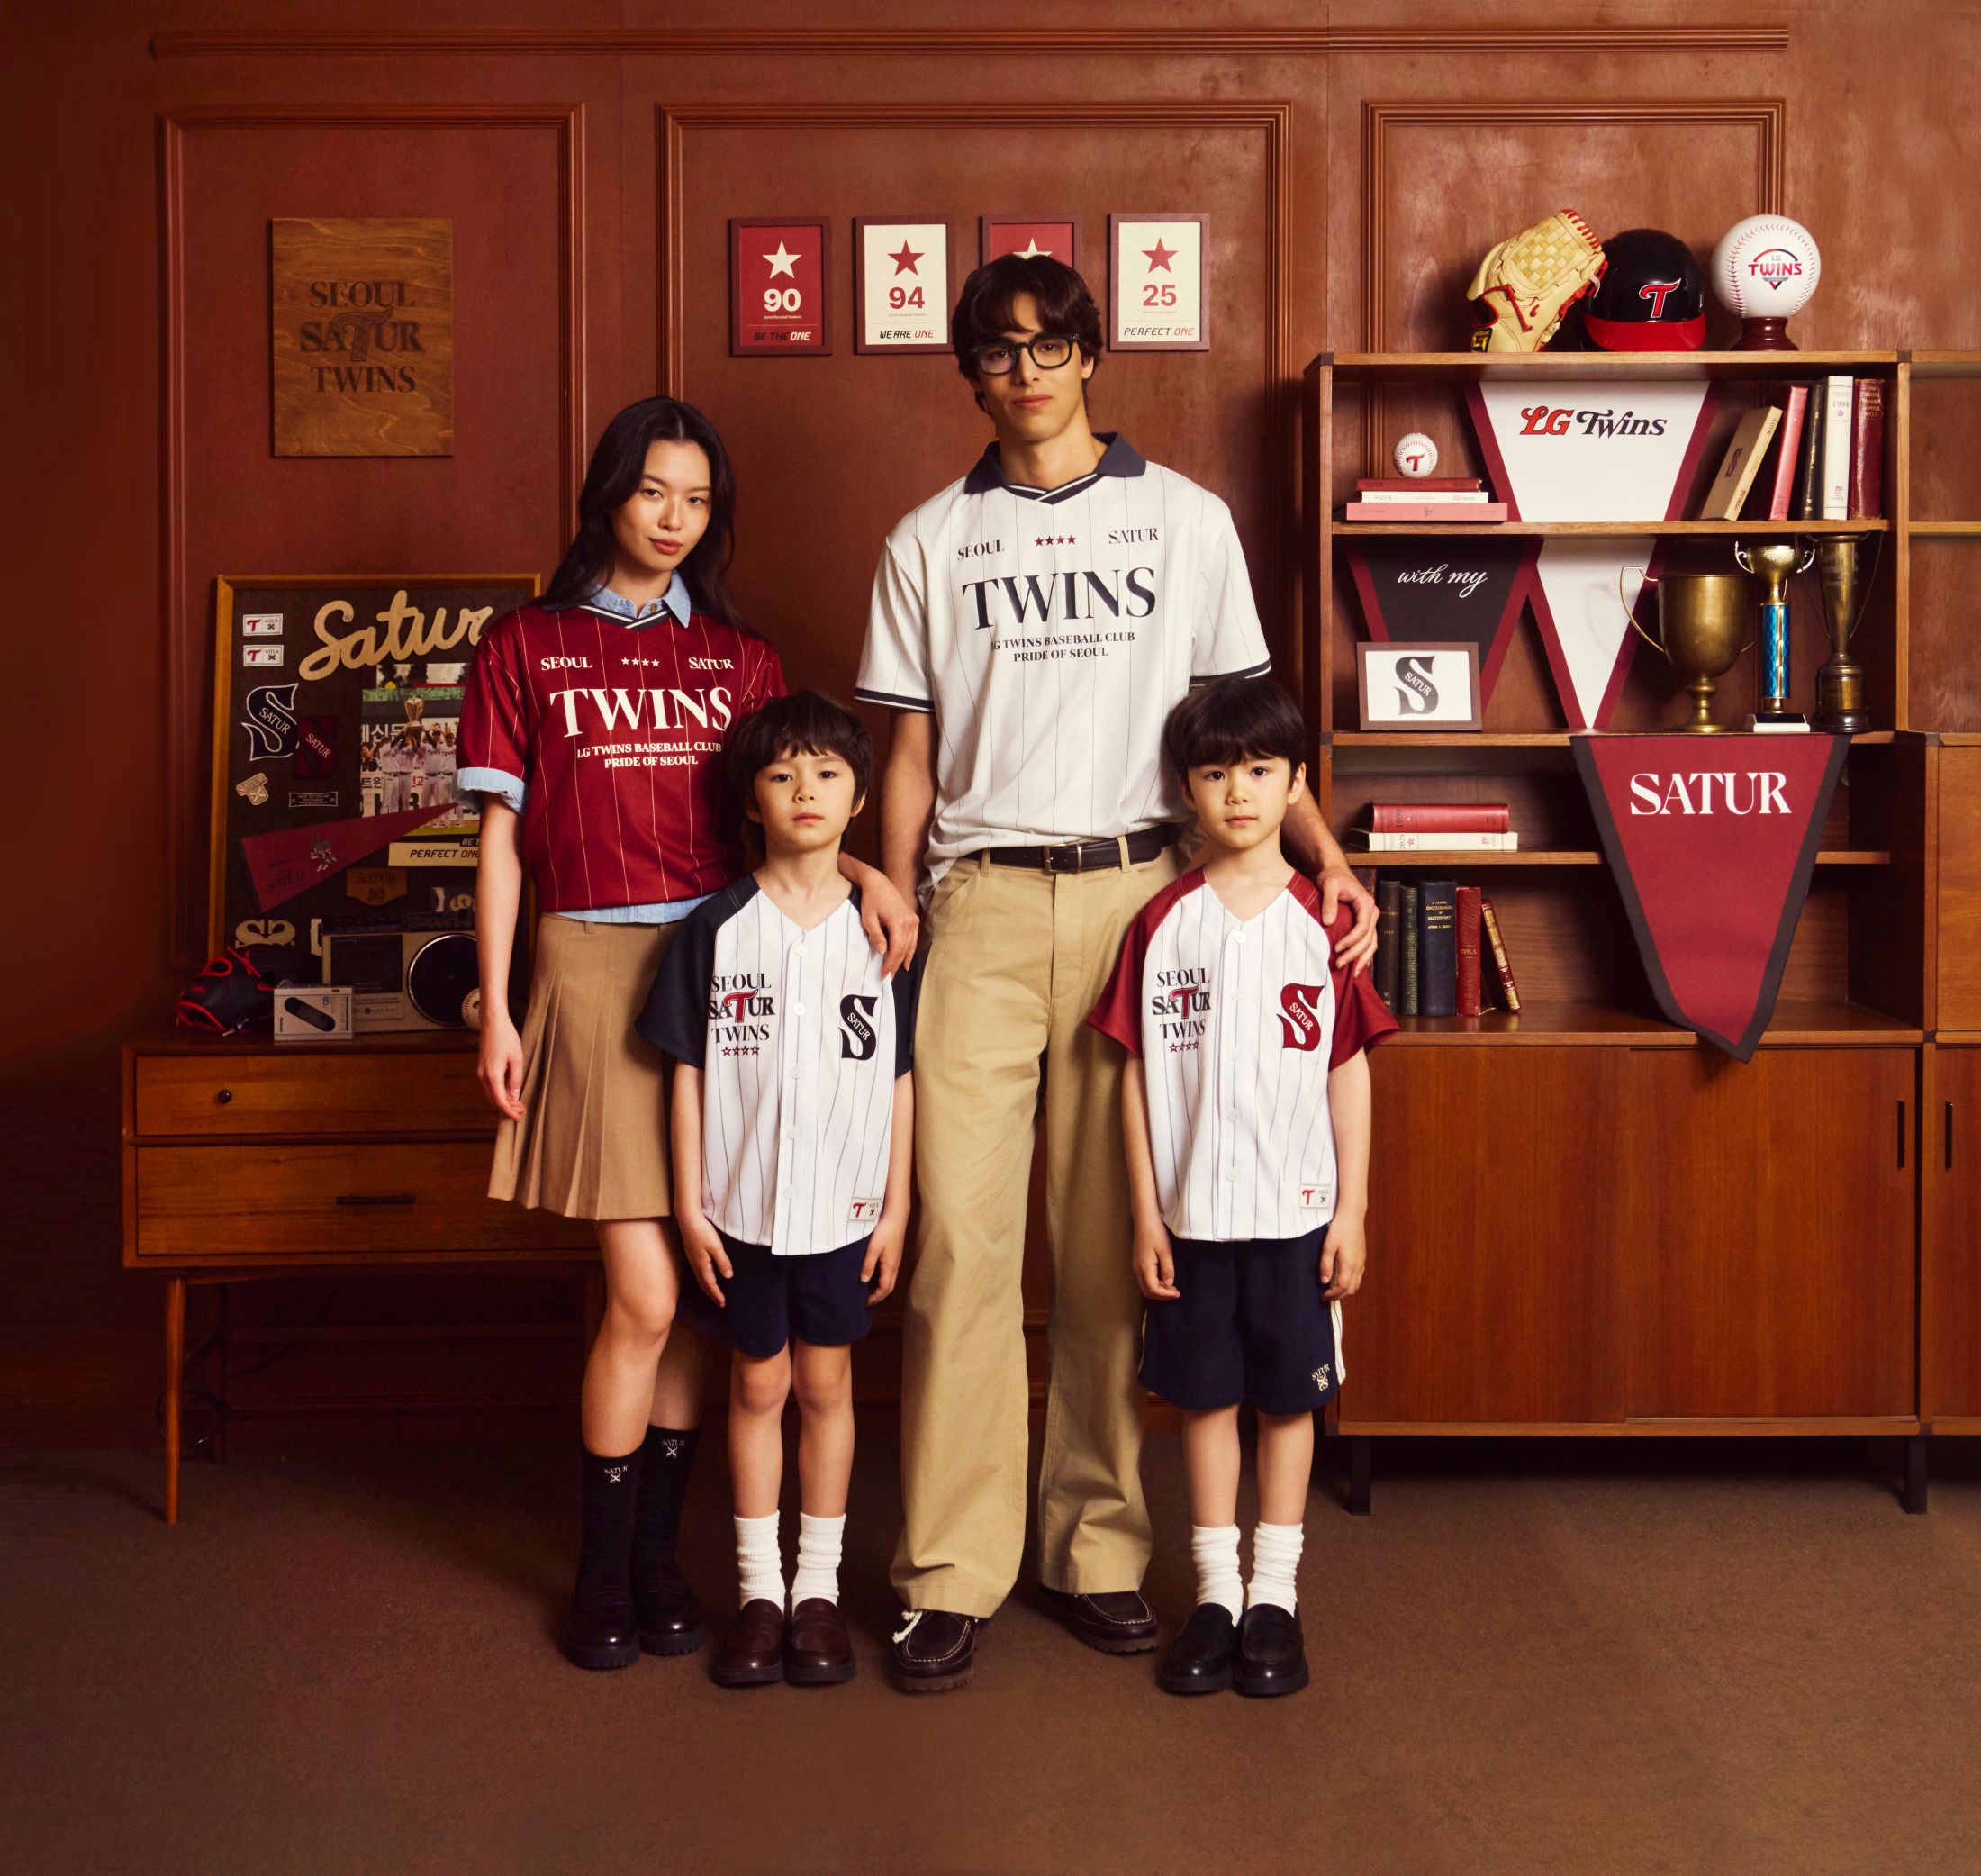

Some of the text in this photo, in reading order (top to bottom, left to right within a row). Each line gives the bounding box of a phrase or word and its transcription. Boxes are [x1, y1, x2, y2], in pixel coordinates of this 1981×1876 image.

[1748, 263, 1803, 276] TWINS
[309, 280, 416, 308] SEOUL
[764, 288, 801, 313] 90
[889, 286, 926, 310] 94
[1143, 284, 1177, 307] 25
[1638, 277, 1682, 319] T
[754, 331, 812, 341] BE THE ONE
[879, 330, 936, 340] WE ARE ONE
[1124, 327, 1195, 336] PERFECT ONE
[311, 366, 416, 393] TWINS
[1520, 405, 1668, 440] LG Twins
[957, 527, 1160, 561] SEOUL SATUR
[1397, 563, 1488, 598] with my
[962, 566, 1156, 630] TWINS
[299, 590, 493, 681] Satur
[1004, 637, 1042, 648] TWINS
[1045, 633, 1102, 646] BASEBALL
[1105, 631, 1135, 642] CLUB
[541, 657, 734, 671] SEOUL SATUR
[1014, 647, 1108, 663] PRIDE OF SEOUL
[1405, 671, 1432, 697] SATUR
[258, 707, 291, 735] SATUR
[550, 686, 732, 738] TWINS
[305, 732, 330, 758] SATUR
[577, 741, 722, 758] LG TWINS BASEBALL CLUB
[604, 756, 698, 769] PRIDE OF SEOUL
[1630, 772, 1792, 815] SATUR
[409, 849, 459, 858] PERFECT
[711, 973, 772, 992] SEOUL
[1156, 968, 1210, 988] SEOUL
[847, 1012, 871, 1040] SATUR
[1289, 1002, 1314, 1031] SATUR
[711, 1023, 770, 1043] TWINS
[1160, 1019, 1206, 1039] TWINS
